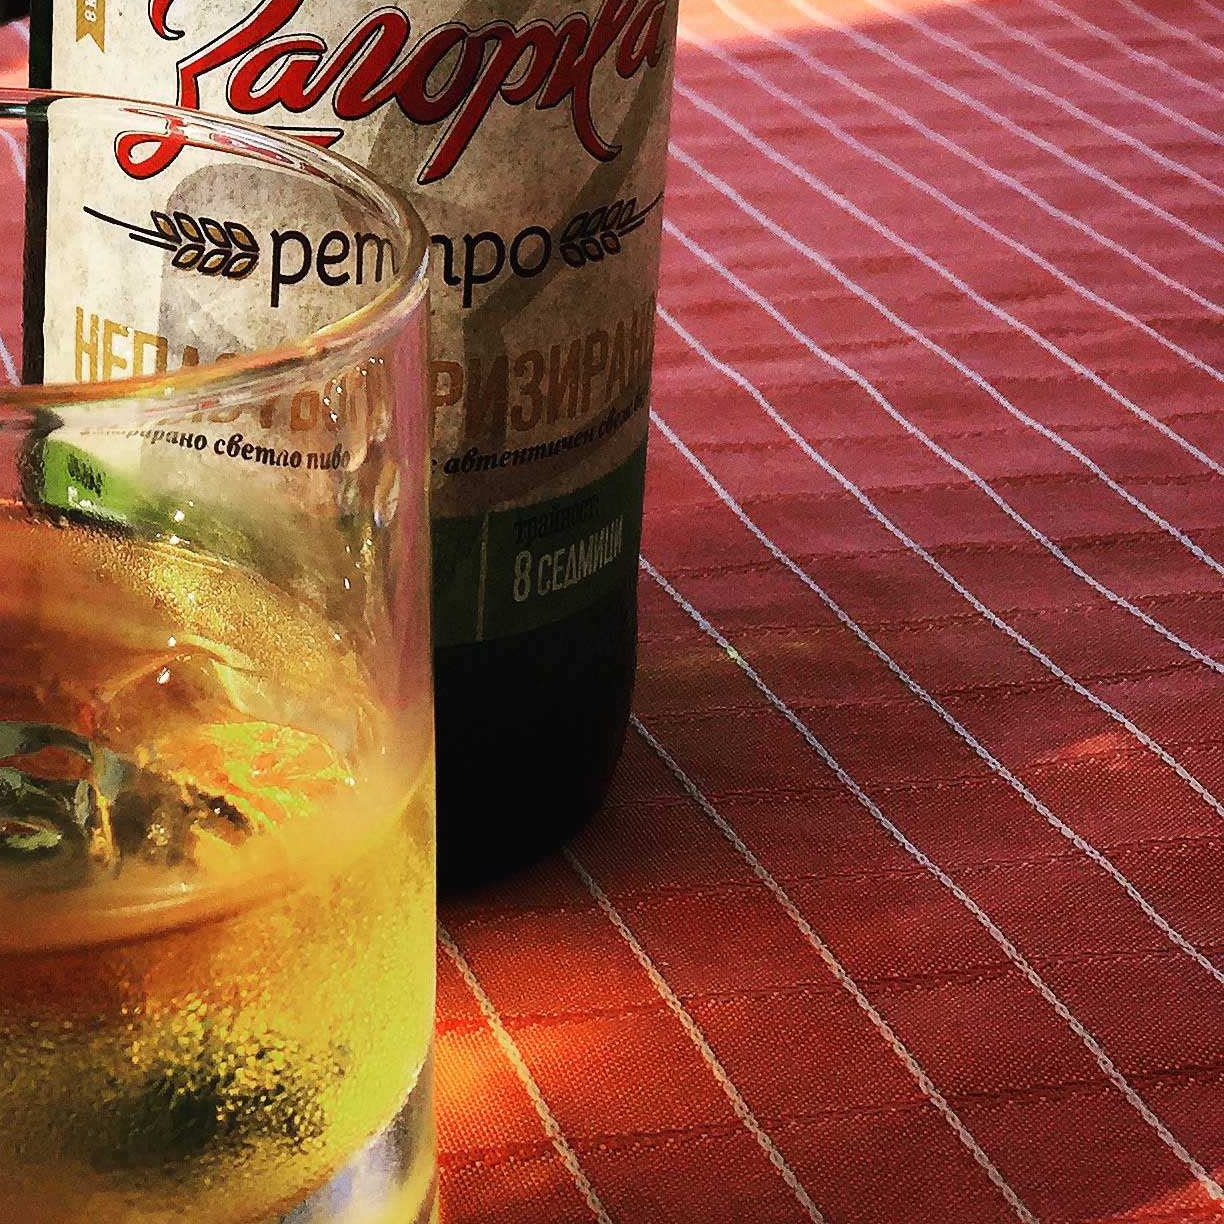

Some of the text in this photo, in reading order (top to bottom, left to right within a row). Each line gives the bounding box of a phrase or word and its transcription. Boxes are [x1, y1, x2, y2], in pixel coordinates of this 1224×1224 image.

[213, 432, 303, 469] светло
[513, 514, 624, 603] 8 СЕДМИЦИ
